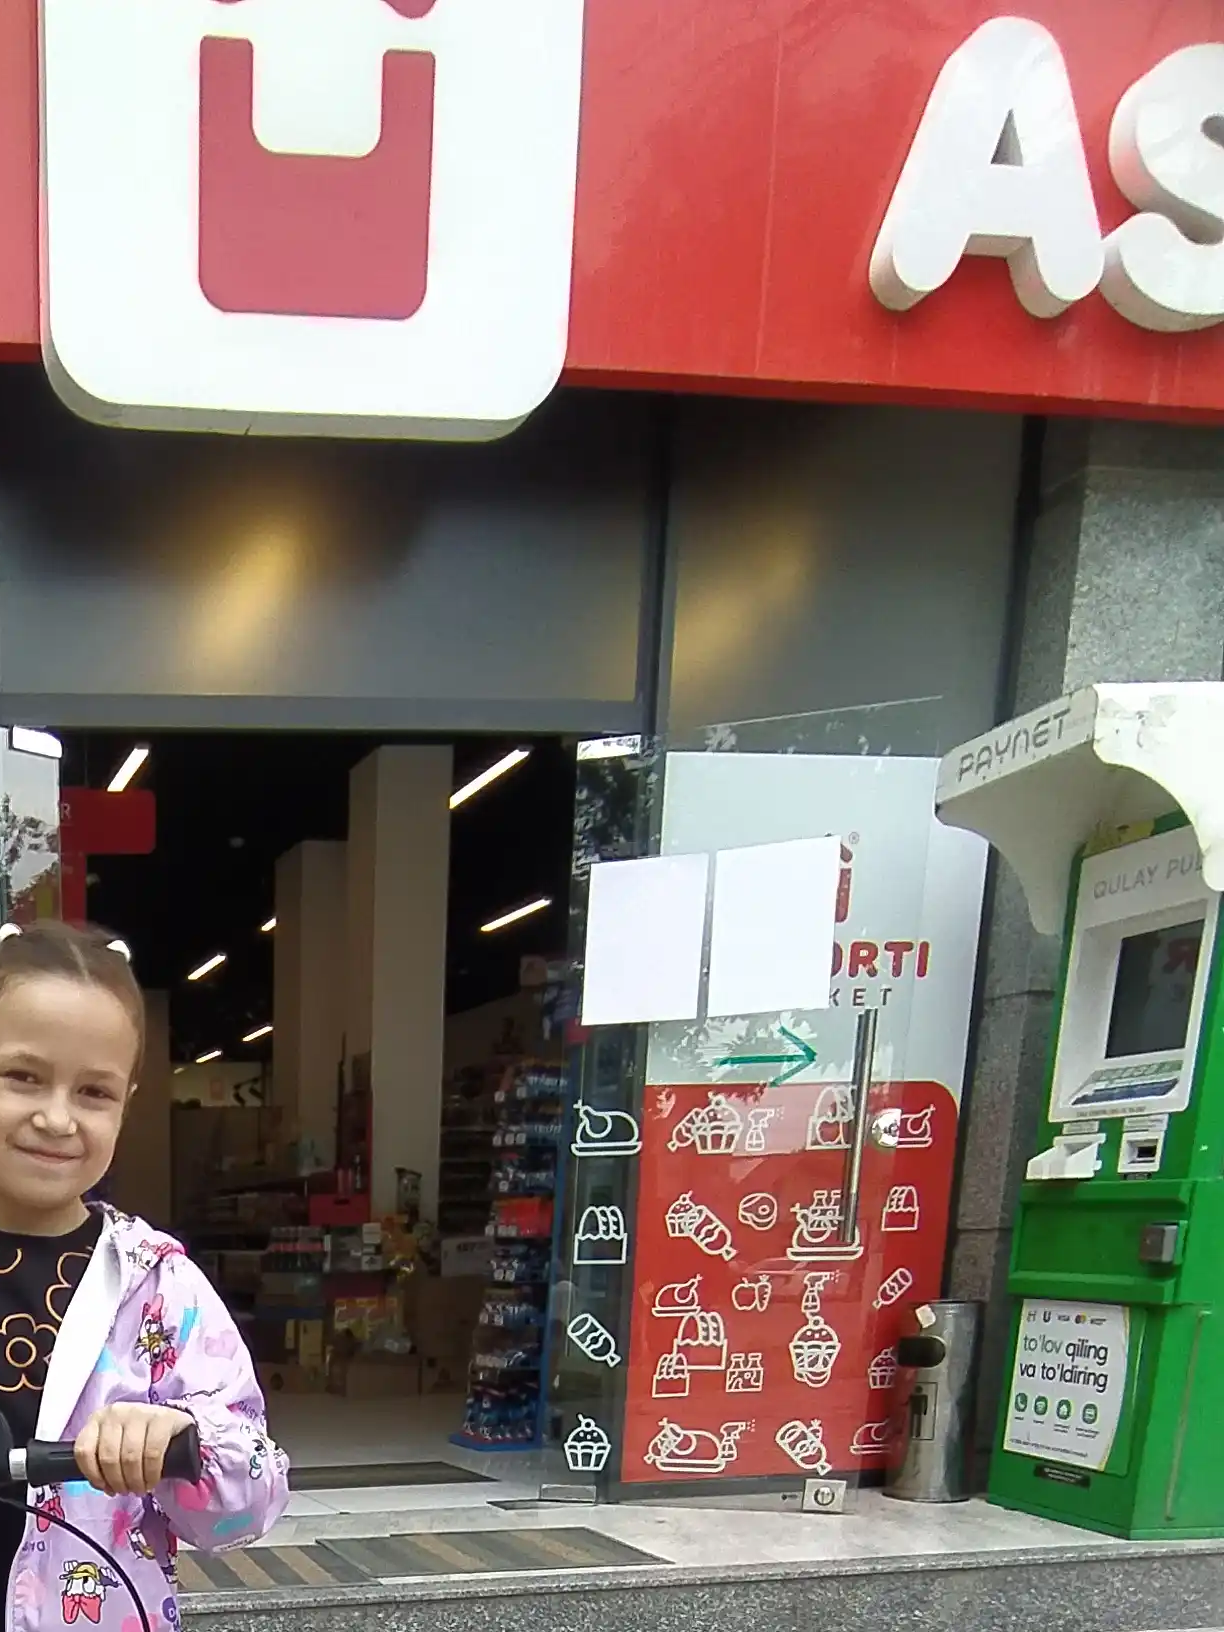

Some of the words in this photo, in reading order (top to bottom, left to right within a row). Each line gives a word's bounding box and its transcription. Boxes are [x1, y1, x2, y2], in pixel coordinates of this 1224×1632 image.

[957, 708, 1072, 783] PAYNET
[1093, 862, 1159, 900] QULAY
[1065, 1338, 1109, 1367] qiling
[1019, 1362, 1037, 1378] va
